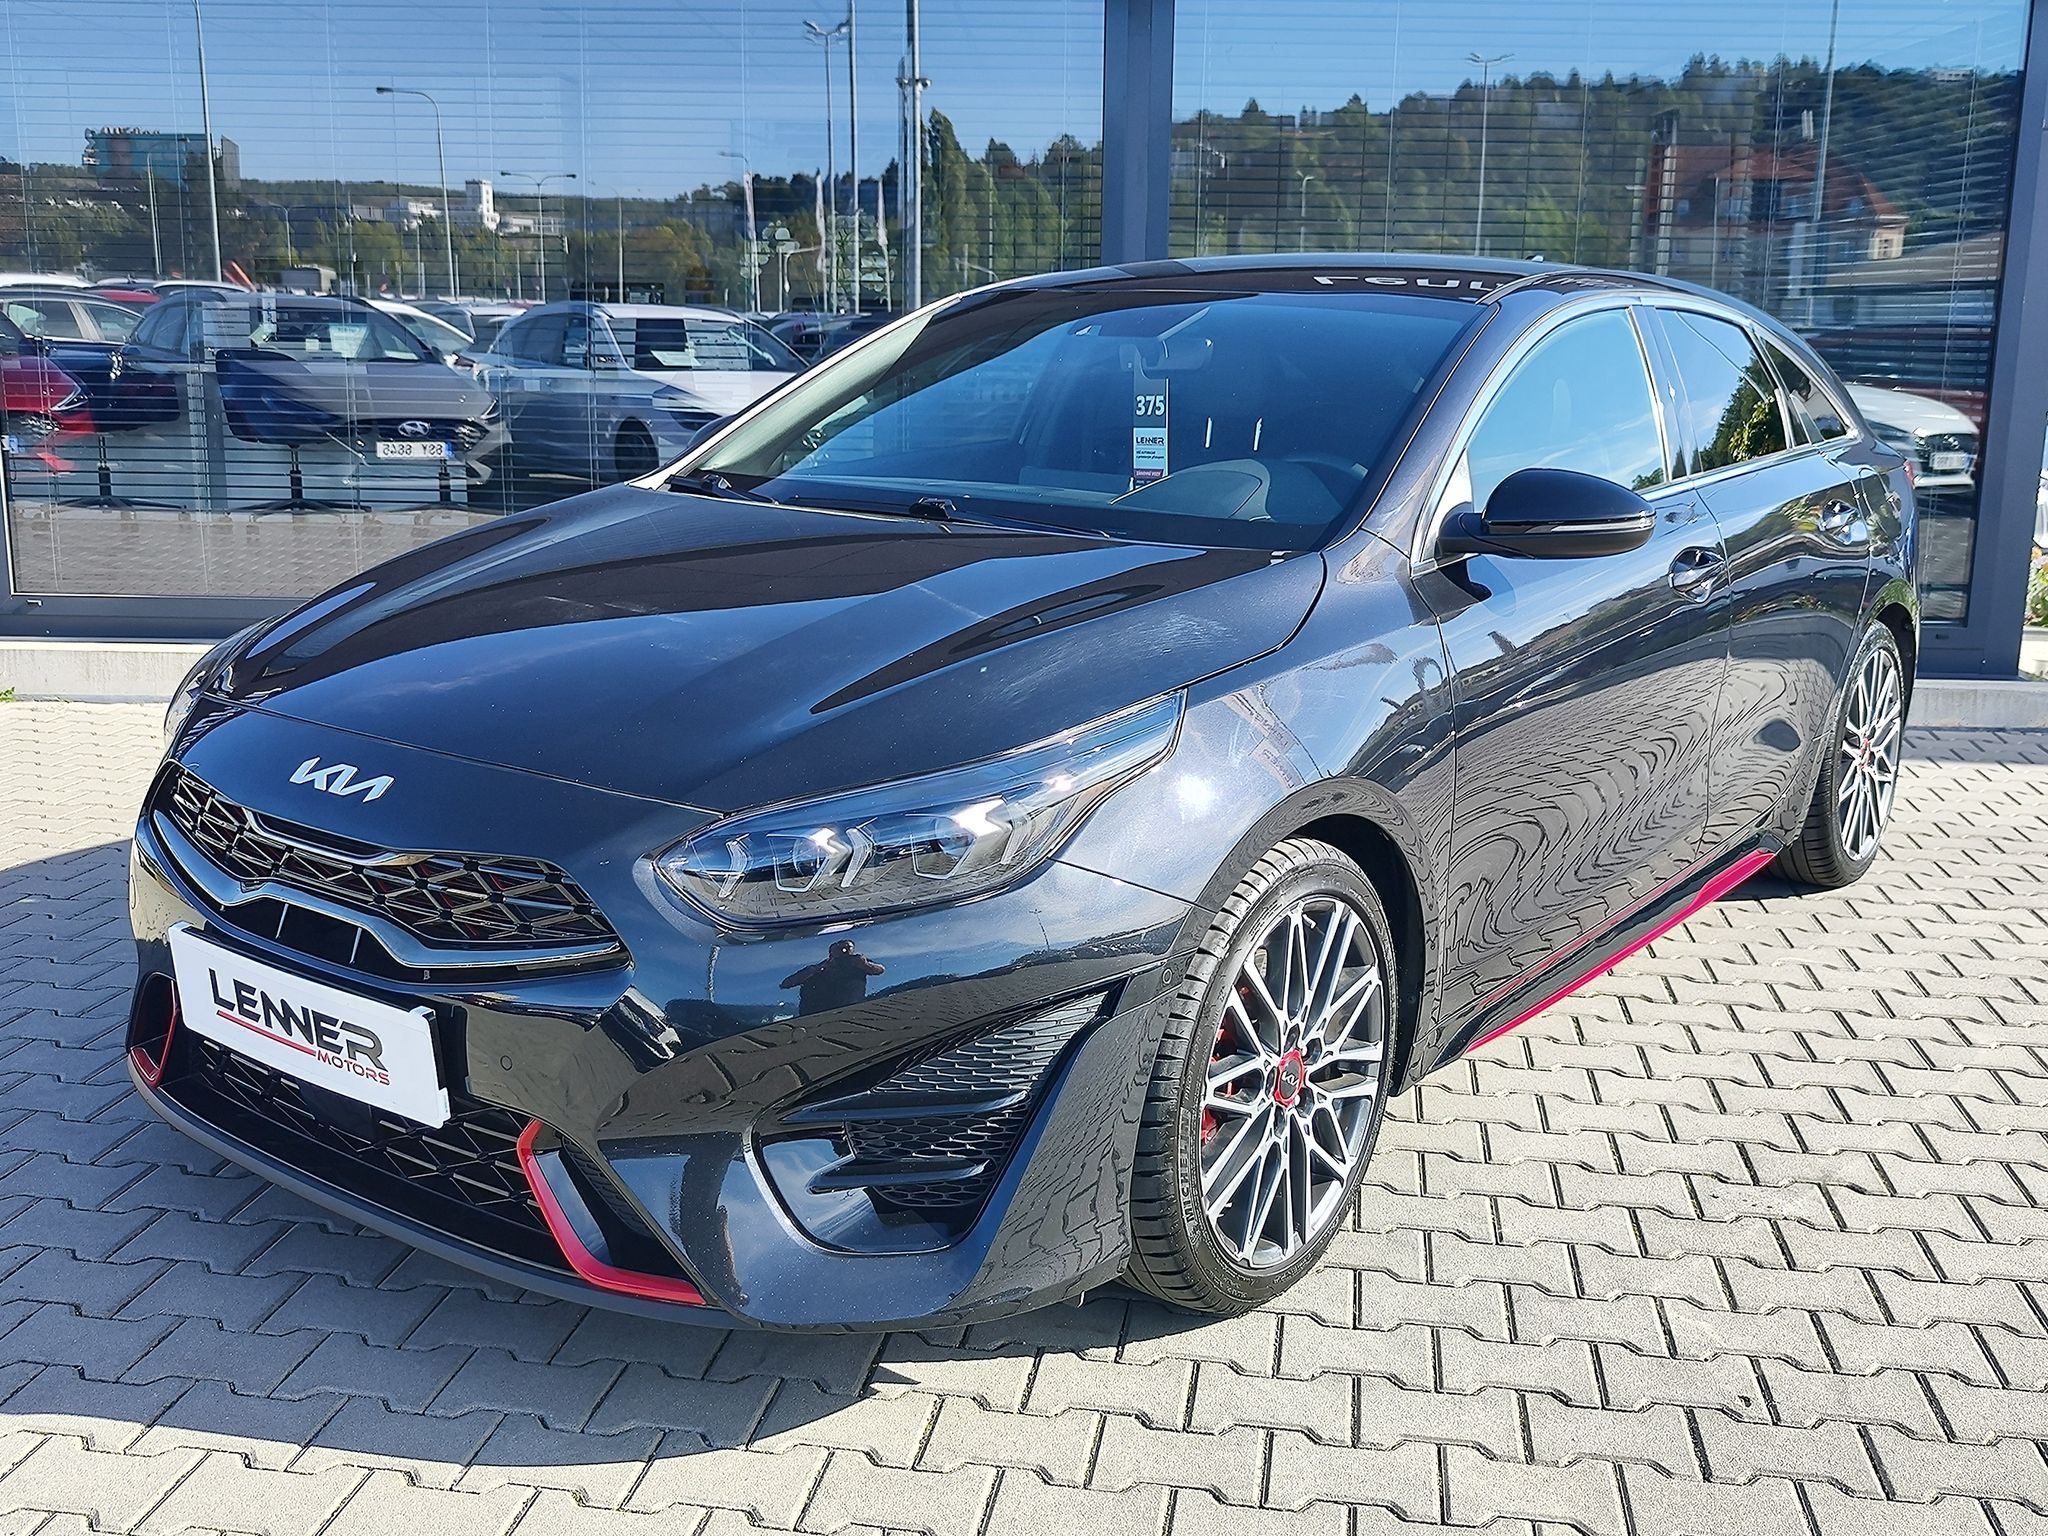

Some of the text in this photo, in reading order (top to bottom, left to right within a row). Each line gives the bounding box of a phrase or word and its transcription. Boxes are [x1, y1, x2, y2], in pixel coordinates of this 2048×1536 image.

[1136, 395, 1165, 416] 375
[1136, 436, 1164, 445] LENNER
[289, 756, 395, 803] KIA
[207, 967, 388, 1072] LENNER
[316, 1048, 391, 1086] MOTORS
[1178, 1115, 1195, 1223] MICHELIN
